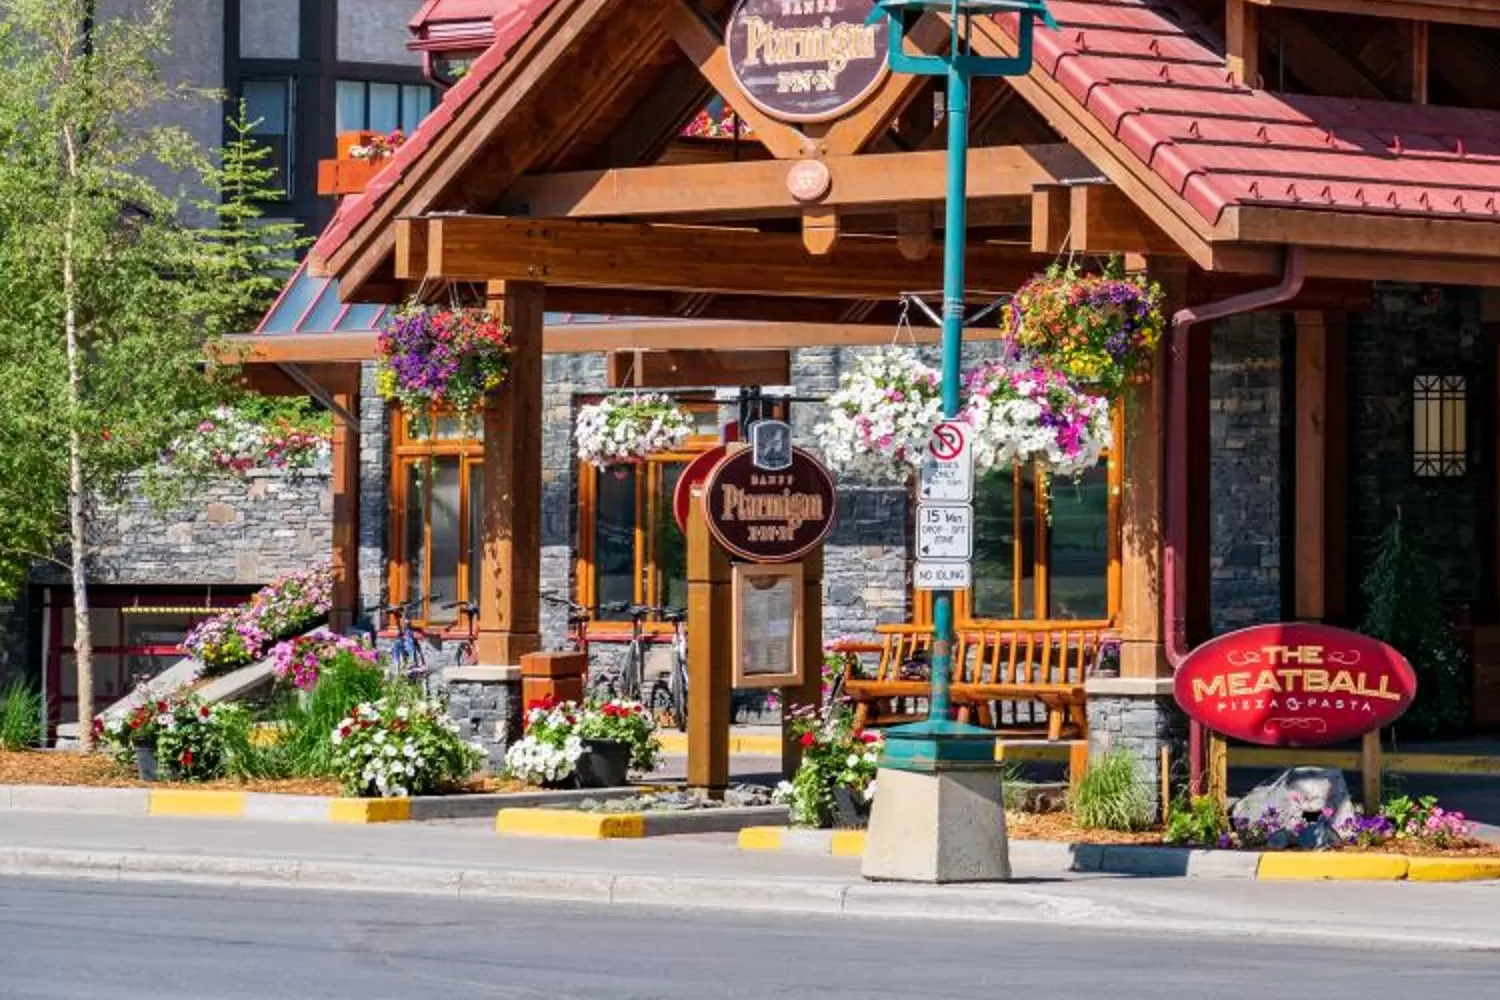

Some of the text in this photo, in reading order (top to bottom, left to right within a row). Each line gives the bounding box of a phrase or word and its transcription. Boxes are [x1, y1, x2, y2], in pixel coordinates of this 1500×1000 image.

[744, 15, 876, 72] Ptarmigan
[721, 483, 824, 529] Ptarmigan
[926, 509, 940, 523] 15
[919, 569, 965, 581] NO IDLING
[1261, 645, 1324, 664] THE
[1192, 669, 1401, 702] MEATBALL
[1217, 699, 1280, 713] PIZZA
[1307, 699, 1372, 712] PASTA
